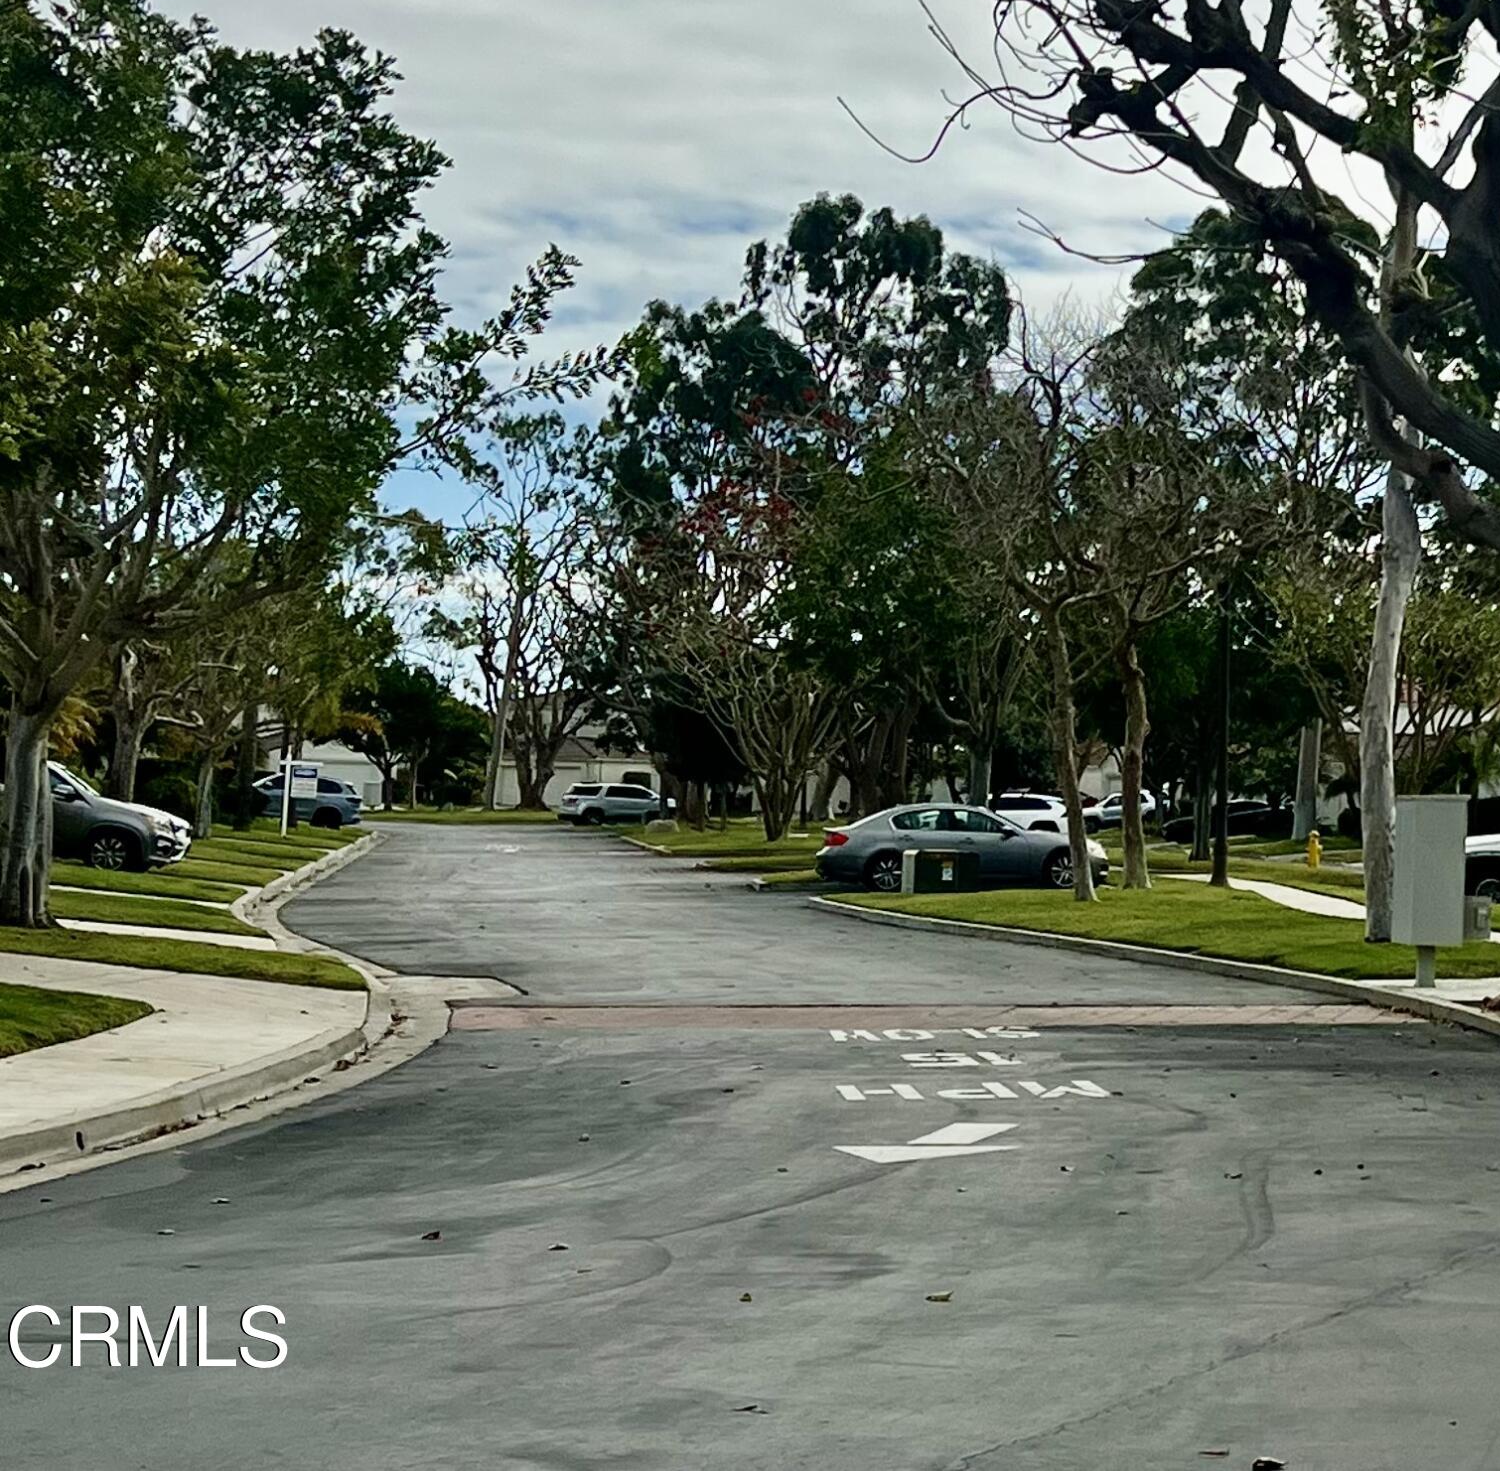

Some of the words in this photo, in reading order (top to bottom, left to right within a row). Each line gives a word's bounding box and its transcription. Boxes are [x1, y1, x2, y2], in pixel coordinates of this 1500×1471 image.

[829, 1025, 1041, 1042] SLOW
[900, 1051, 1022, 1068] 15
[835, 1080, 1111, 1101] MPH
